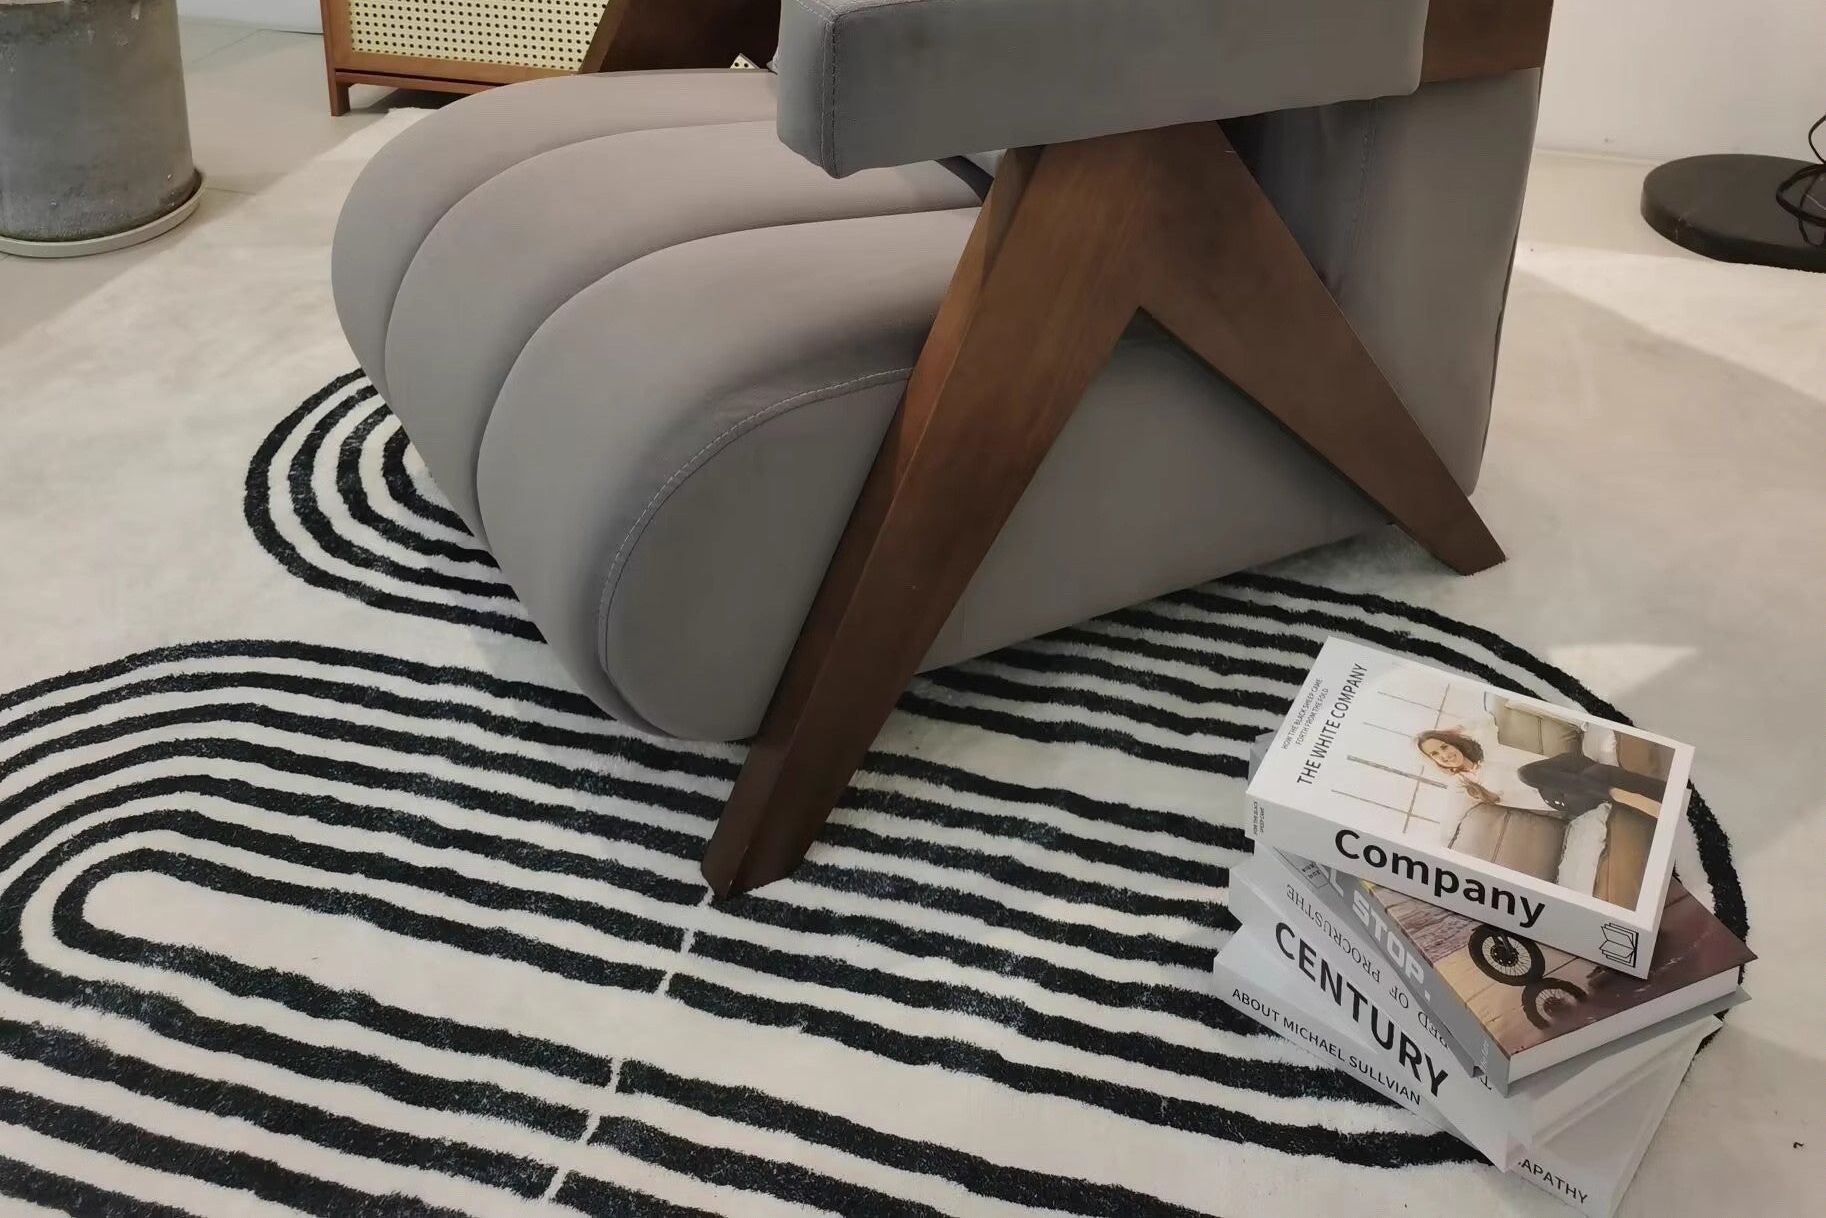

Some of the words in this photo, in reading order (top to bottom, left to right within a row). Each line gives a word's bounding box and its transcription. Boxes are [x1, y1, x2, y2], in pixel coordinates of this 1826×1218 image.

[1297, 759, 1322, 785] THE
[1310, 719, 1341, 758] WHITE
[1330, 663, 1368, 719] COMPANY
[1335, 829, 1546, 929] Company
[1232, 988, 1280, 1022] ABOUT
[1283, 1016, 1345, 1062] MICHAEL
[1349, 1055, 1422, 1106] SULLVIAN
[1275, 922, 1449, 1098] CENTURY
[1388, 985, 1409, 1009] OF
[1521, 1158, 1588, 1204] APATHY
